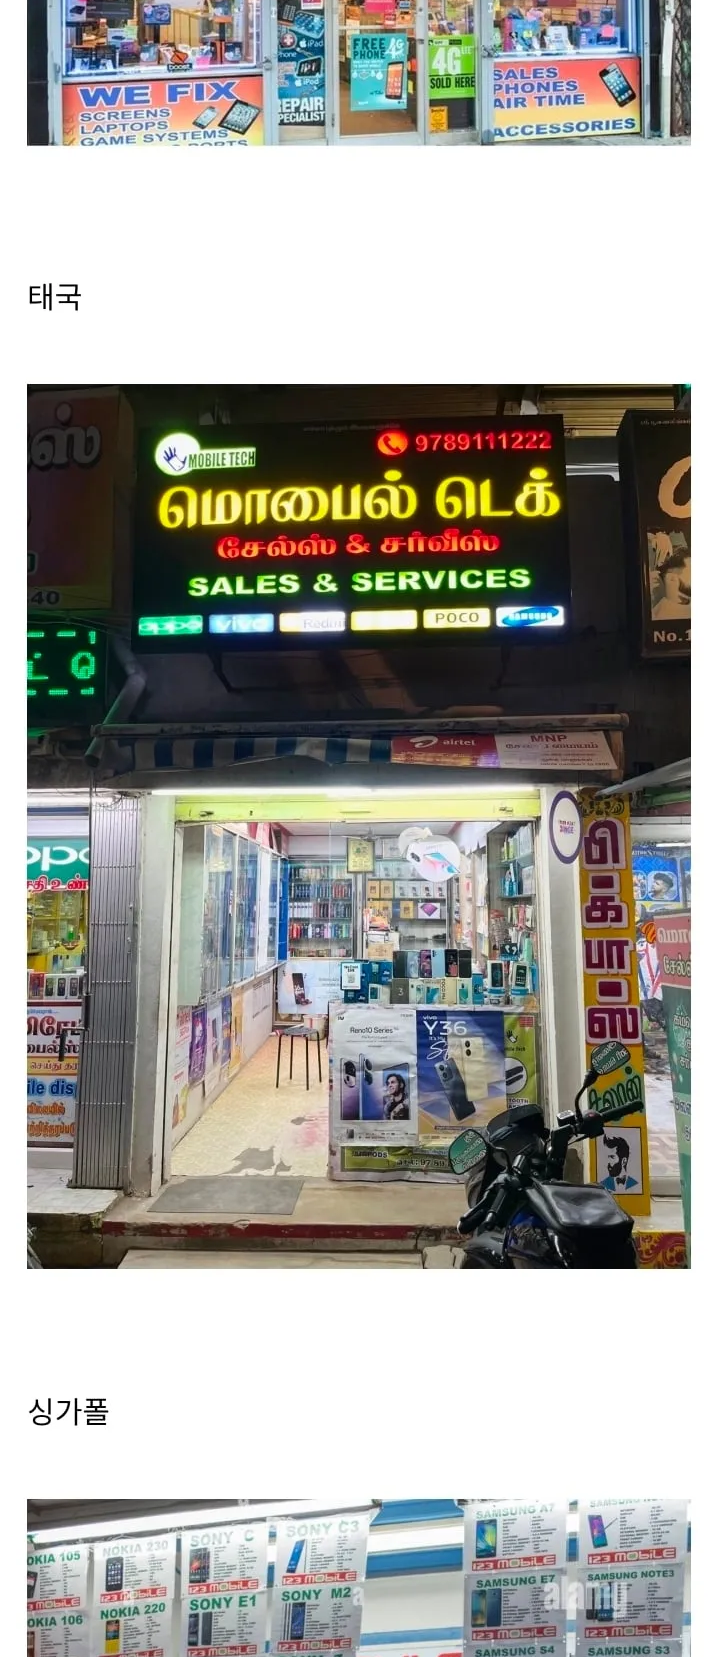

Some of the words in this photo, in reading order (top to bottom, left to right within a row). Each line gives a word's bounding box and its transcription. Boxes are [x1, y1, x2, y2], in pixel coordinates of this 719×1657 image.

[353, 38, 386, 50] FREE
[353, 50, 386, 59] PHONE
[493, 67, 558, 80] SALES
[80, 85, 151, 107] WE
[167, 80, 239, 103] FIX
[493, 80, 578, 95] PHONES
[80, 108, 170, 122] SCREENS
[80, 121, 168, 135] LAPTOPS
[415, 432, 552, 452] 9789111222
[188, 452, 226, 469] MOBILE
[228, 451, 256, 467] TECH
[158, 469, 418, 529] மொபைல்
[436, 467, 561, 520] டெக்
[346, 533, 370, 553] &
[188, 574, 300, 597] SALES
[313, 573, 339, 594] &
[352, 568, 532, 592] SERVICES
[434, 611, 480, 624] POCO
[423, 1020, 467, 1035] Y36
[189, 1597, 233, 1611] SONY
[238, 1595, 256, 1608] E1
[281, 1589, 322, 1603] SONY
[330, 1588, 351, 1599] M2
[475, 1647, 537, 1657] SAMSUNG
[539, 1645, 556, 1654] S4
[587, 1647, 651, 1657] SAMSUNG
[654, 1646, 671, 1655] S3
